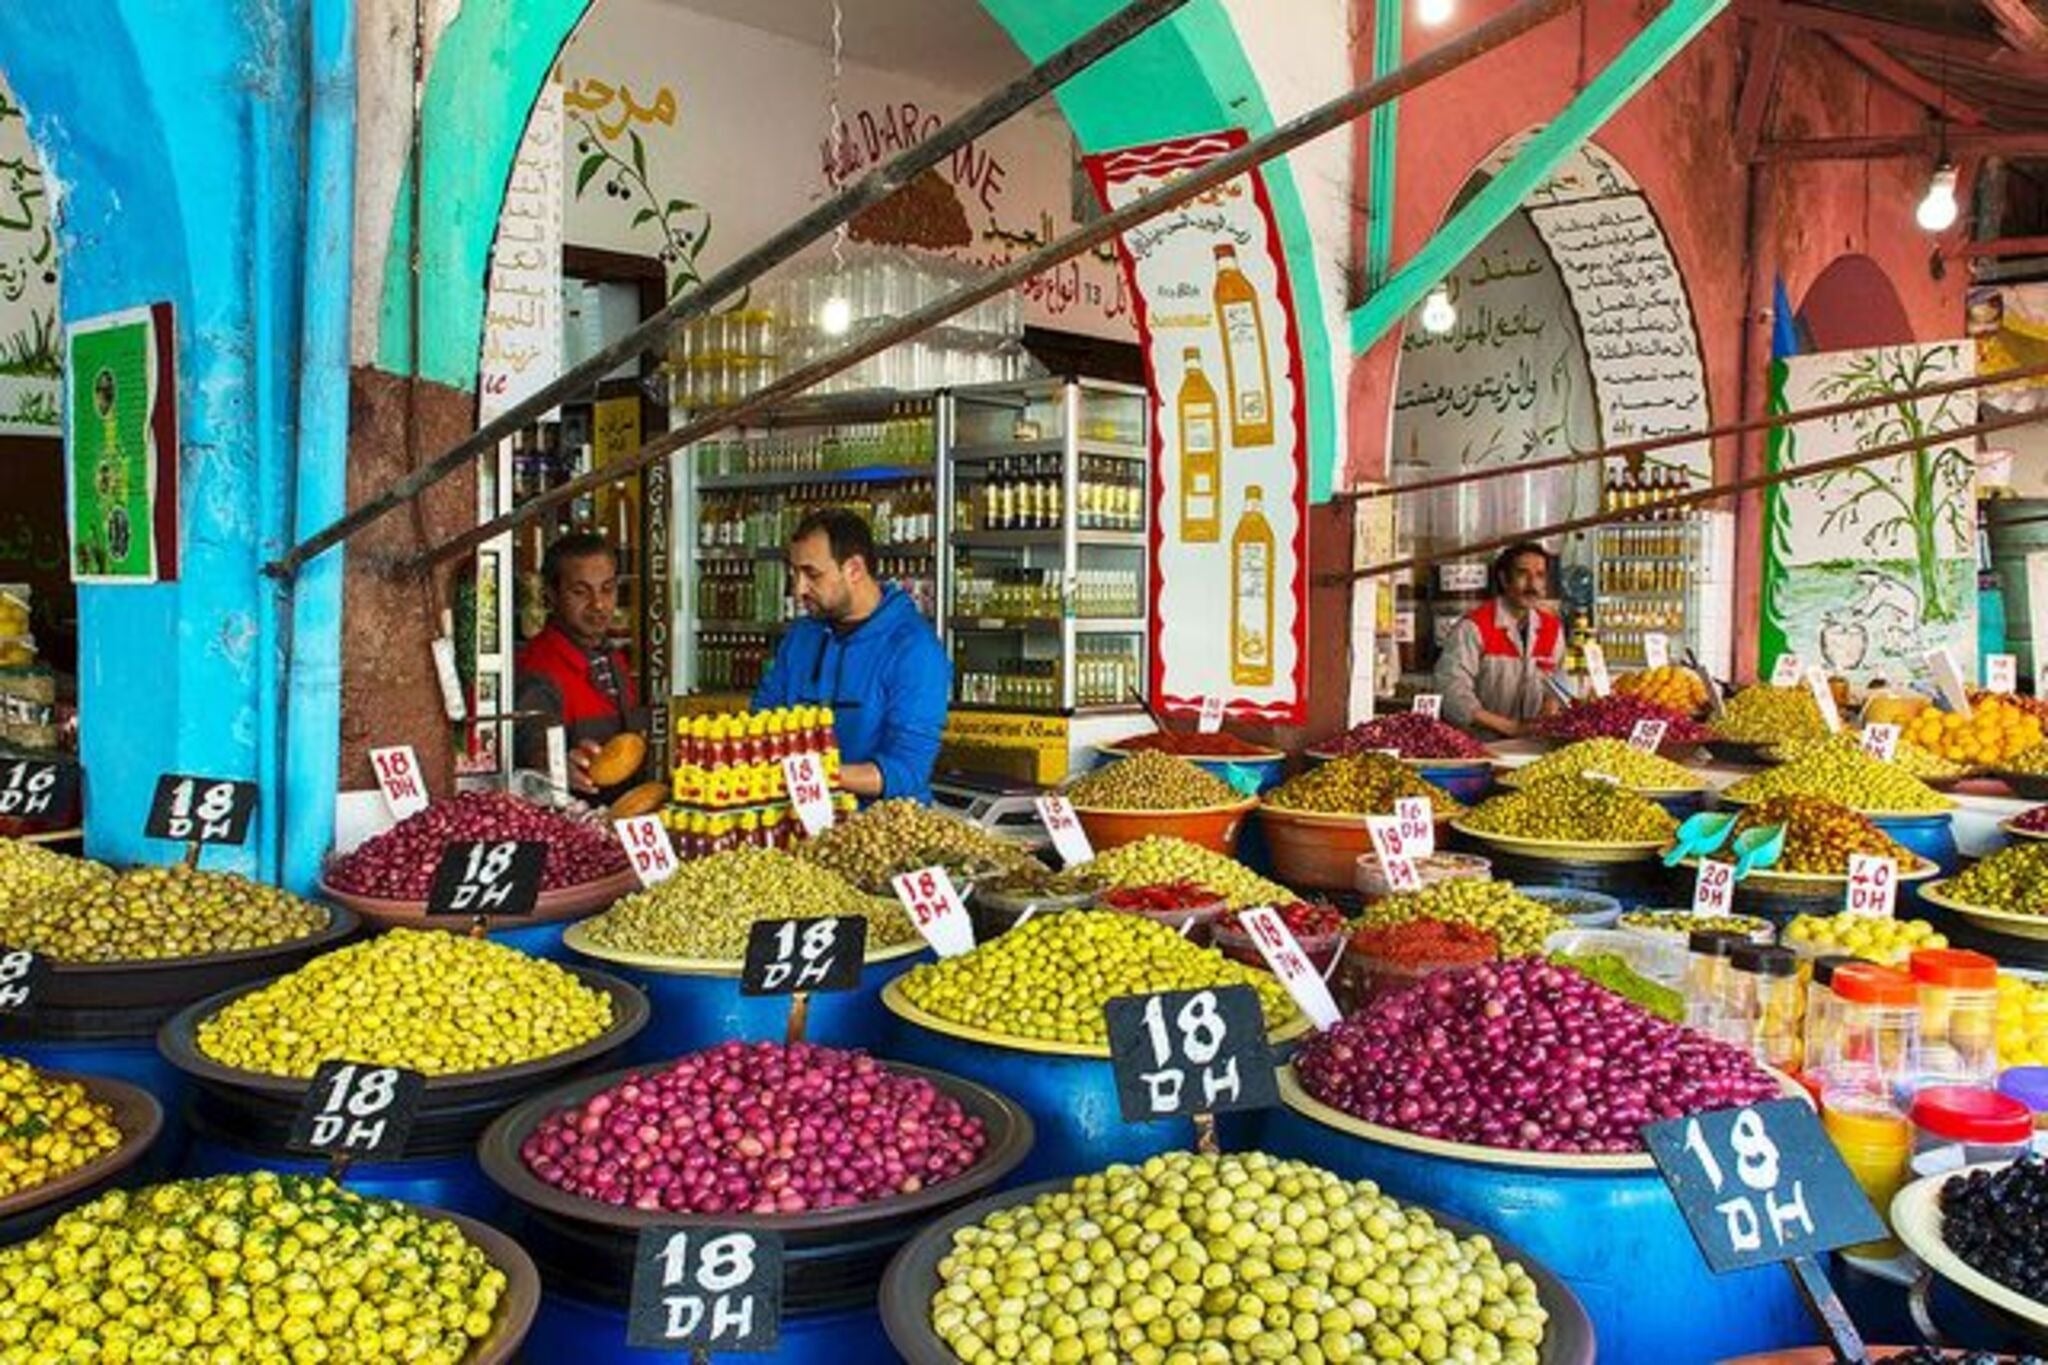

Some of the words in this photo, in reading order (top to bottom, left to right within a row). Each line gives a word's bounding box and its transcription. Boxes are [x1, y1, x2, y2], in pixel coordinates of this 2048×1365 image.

[8, 764, 56, 793] 16
[377, 752, 411, 779] 18
[788, 757, 812, 782] 18
[0, 789, 51, 815] DH
[170, 780, 235, 818] 18
[386, 777, 418, 801] DH
[796, 783, 822, 803] DH
[167, 817, 233, 840] DH
[627, 822, 658, 850] 18
[1378, 826, 1402, 854] 18
[1401, 822, 1428, 838] DH
[461, 842, 517, 885] 18
[637, 849, 670, 875] DH
[1703, 864, 1729, 887] 20
[450, 882, 512, 909] DH
[900, 871, 938, 902] 18
[1698, 885, 1724, 907] DH
[1852, 889, 1887, 911] DH
[914, 899, 952, 927] DH
[775, 920, 839, 957] 18
[0, 950, 34, 983] 8
[762, 960, 834, 988] DH
[0, 980, 31, 1007] H
[1141, 990, 1226, 1068] 18
[325, 1065, 399, 1118] 18
[1141, 1056, 1240, 1113] DH
[310, 1115, 386, 1151] DH
[1683, 1108, 1781, 1193] 18
[1717, 1181, 1815, 1253] DH
[656, 1230, 757, 1292] 18
[661, 1293, 754, 1341] DH
